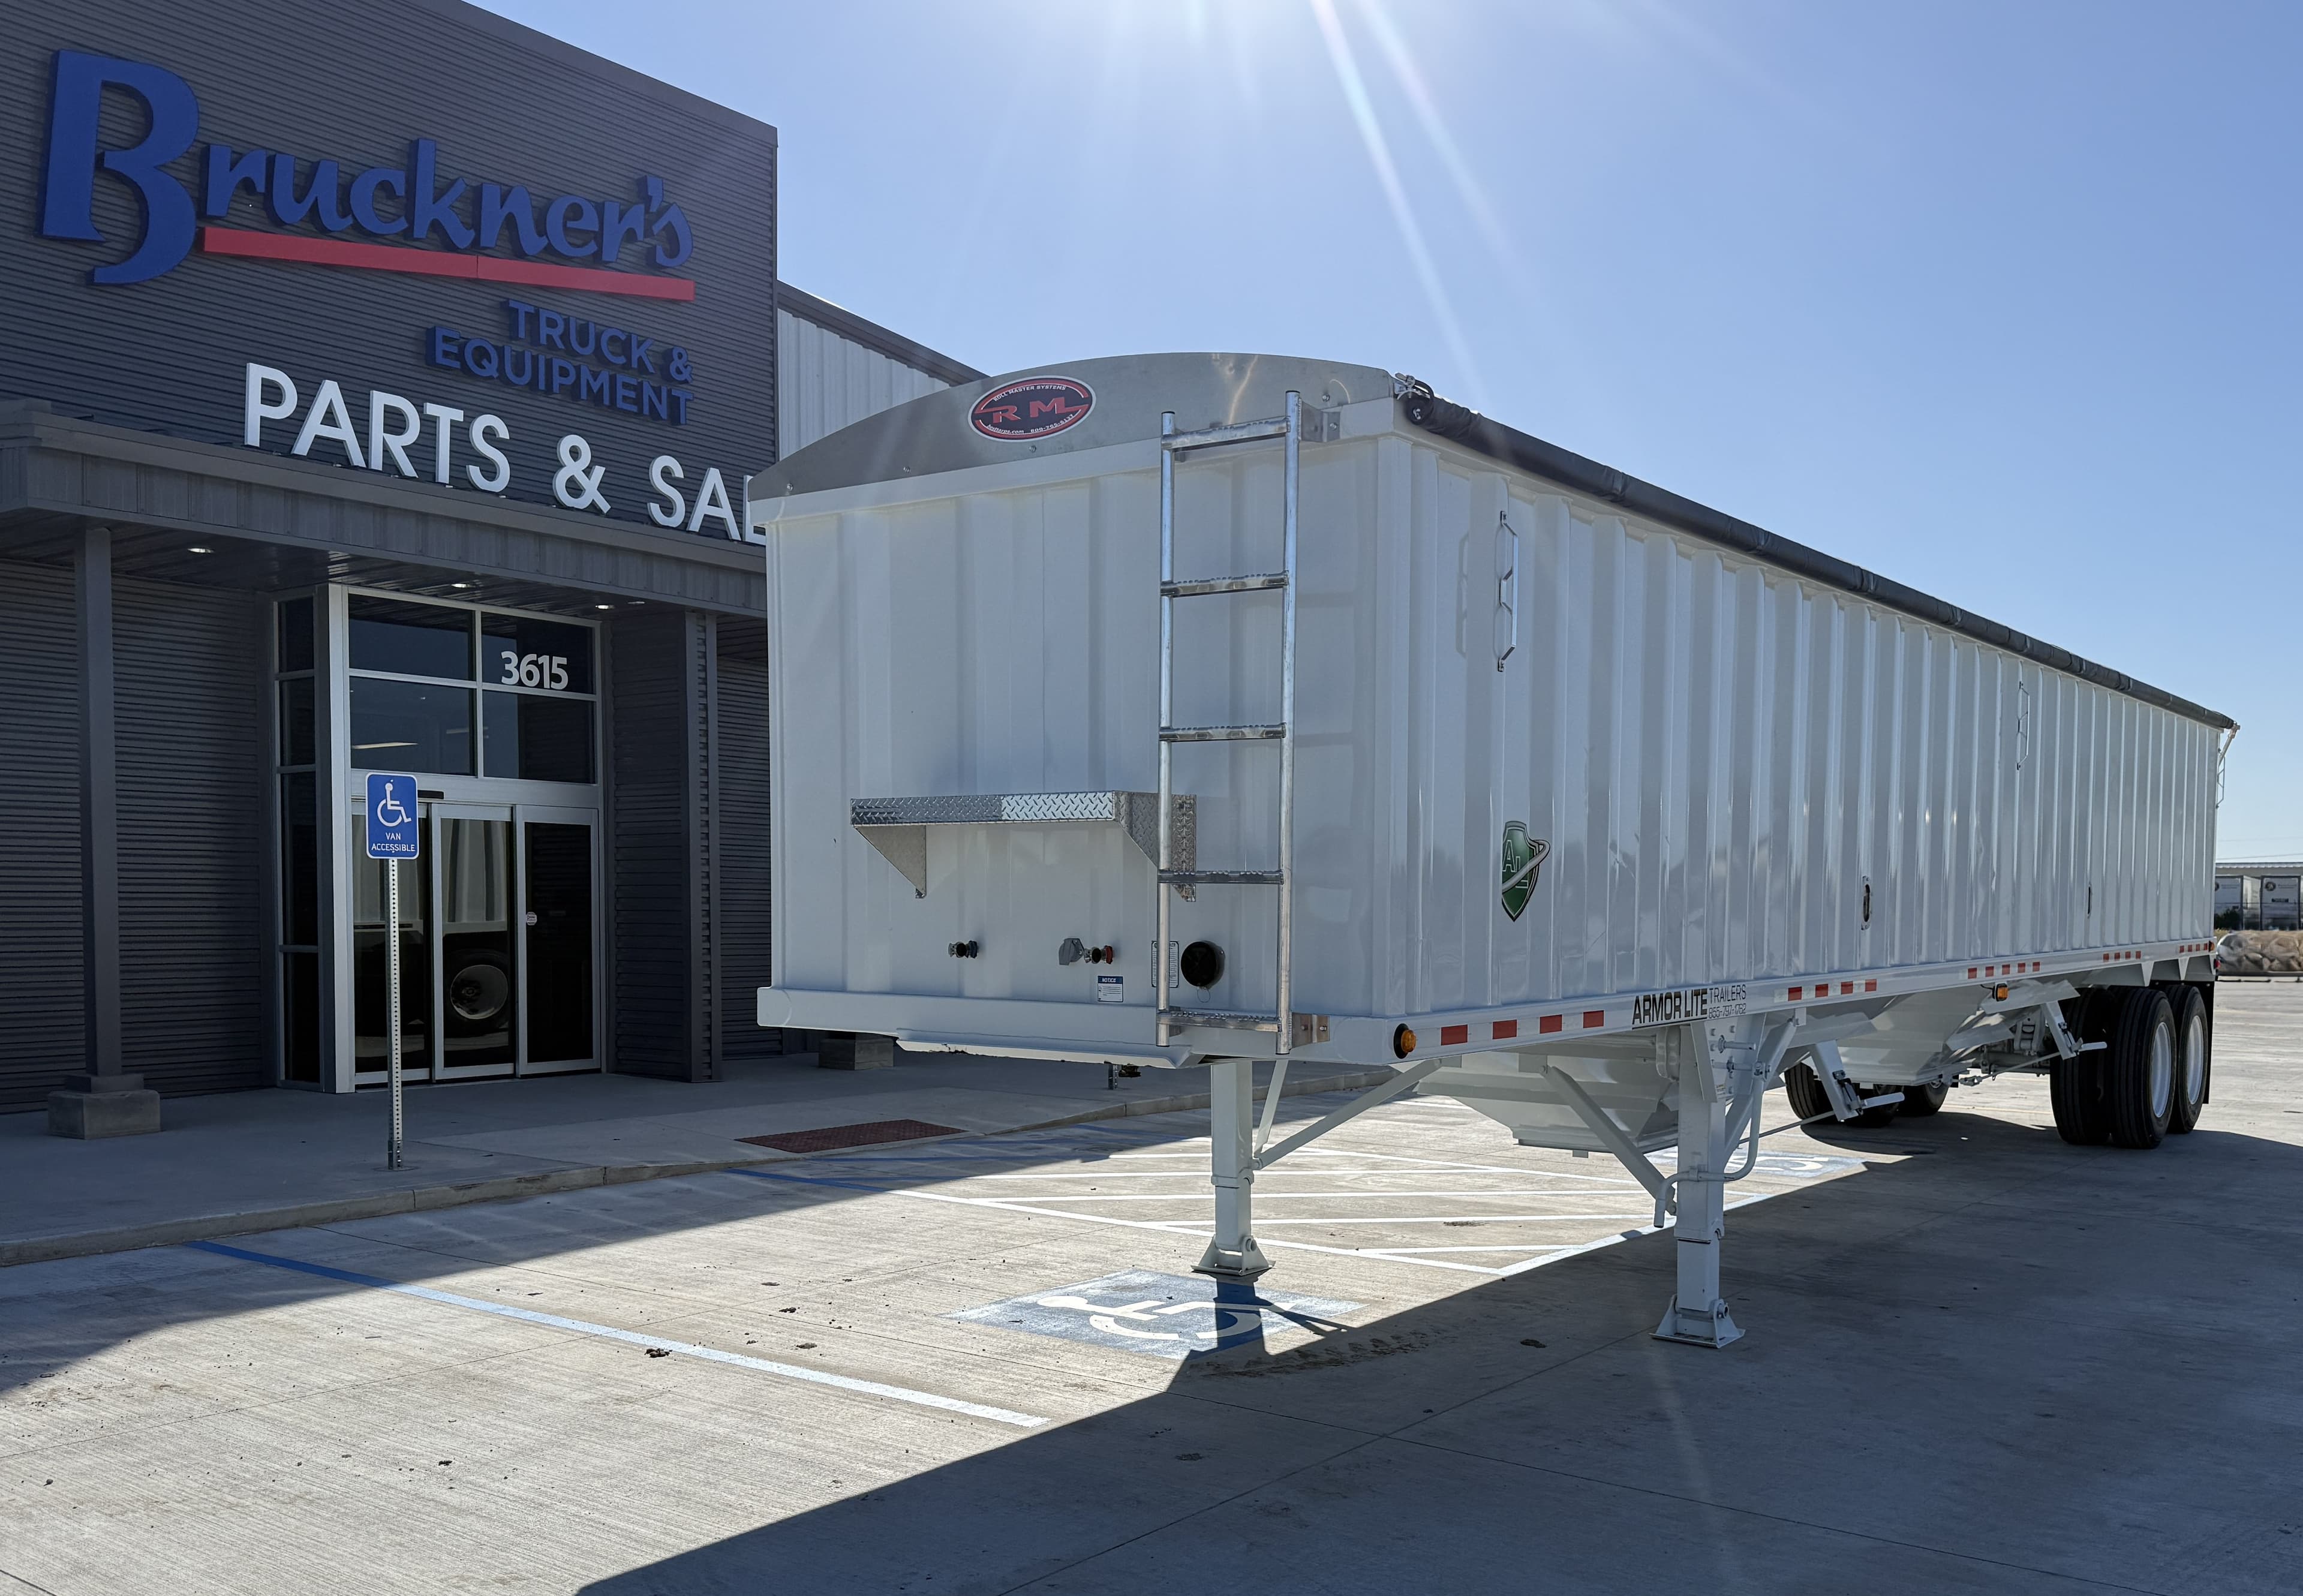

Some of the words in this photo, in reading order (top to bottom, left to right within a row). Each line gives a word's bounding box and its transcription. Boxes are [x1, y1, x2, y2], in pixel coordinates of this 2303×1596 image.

[41, 49, 694, 284] Bruckner's
[501, 299, 655, 374] TRUCK
[662, 347, 694, 384] &
[426, 326, 694, 425] EQUIPMENT
[244, 362, 511, 492] PARTS
[552, 434, 611, 513] &
[501, 651, 569, 690] 3615
[371, 843, 416, 852] ACCESSIBLE
[385, 832, 401, 840] VAN
[1709, 984, 1746, 1004] TRAILERS
